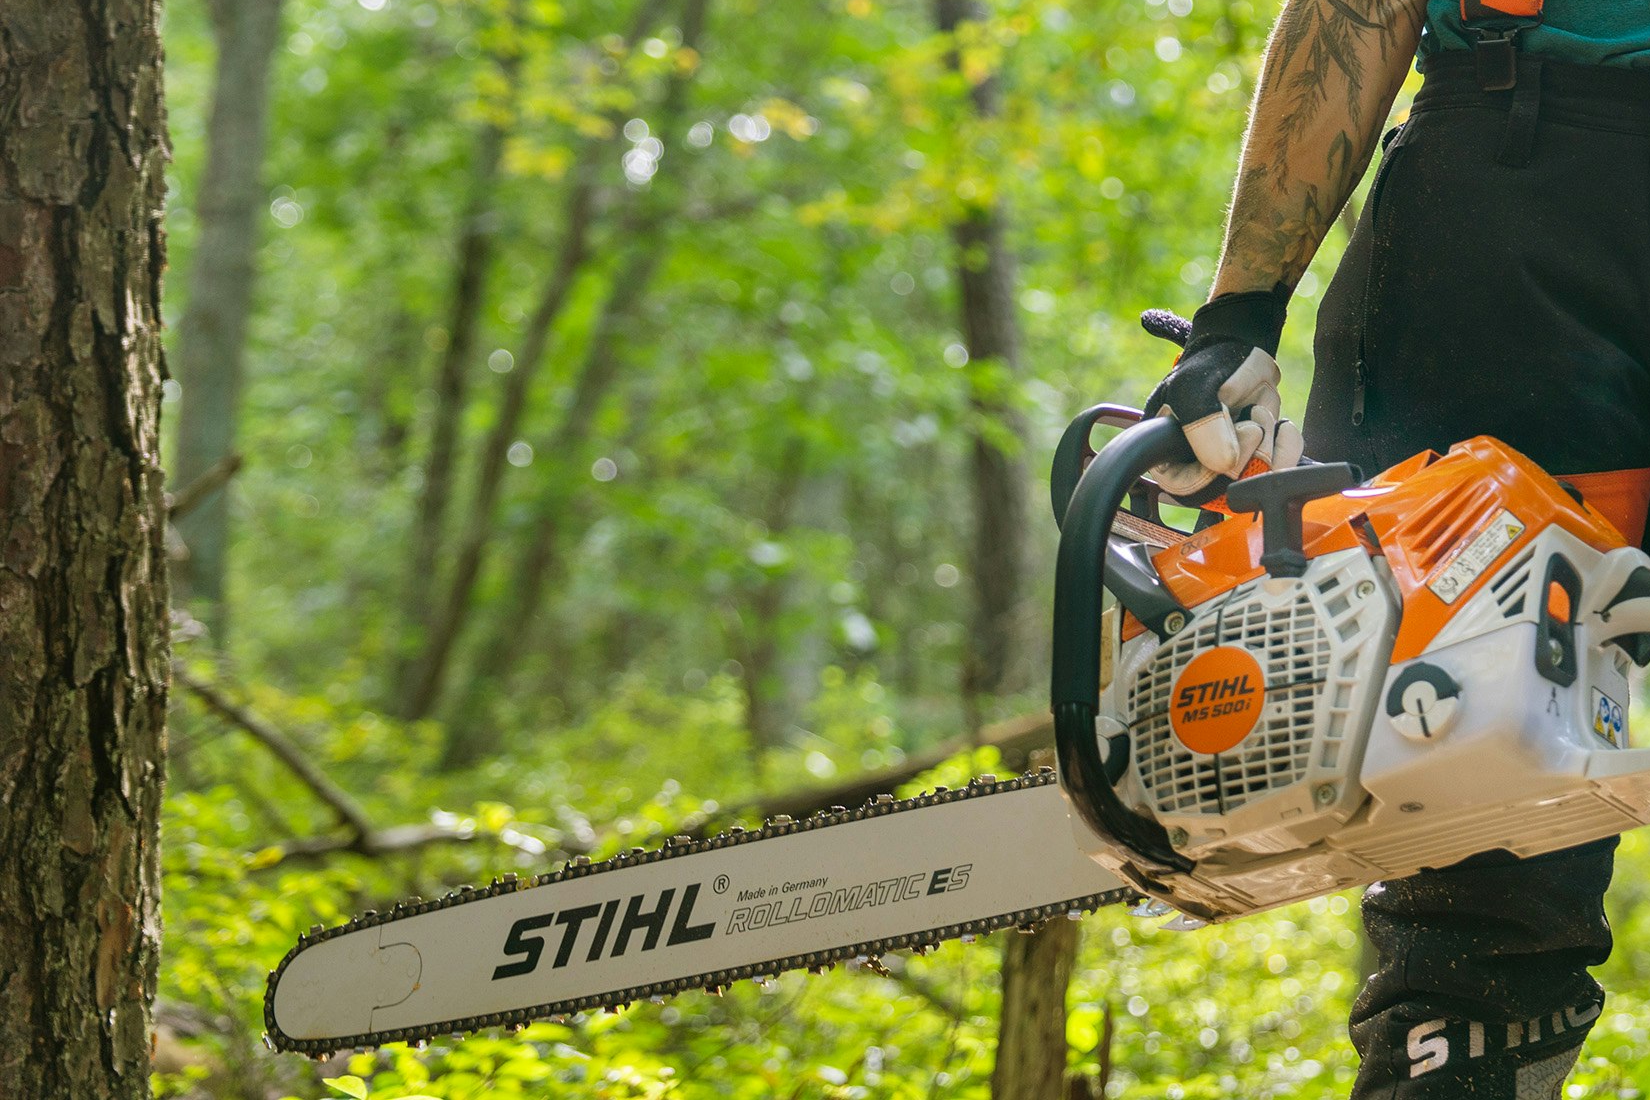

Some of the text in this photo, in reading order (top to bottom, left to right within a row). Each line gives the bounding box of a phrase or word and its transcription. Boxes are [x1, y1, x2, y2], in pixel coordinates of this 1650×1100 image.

[1176, 674, 1255, 709] STIHL
[1182, 706, 1210, 725] MS
[725, 863, 973, 936] ROLLOMATIC ES
[736, 876, 829, 903] Made in Germany
